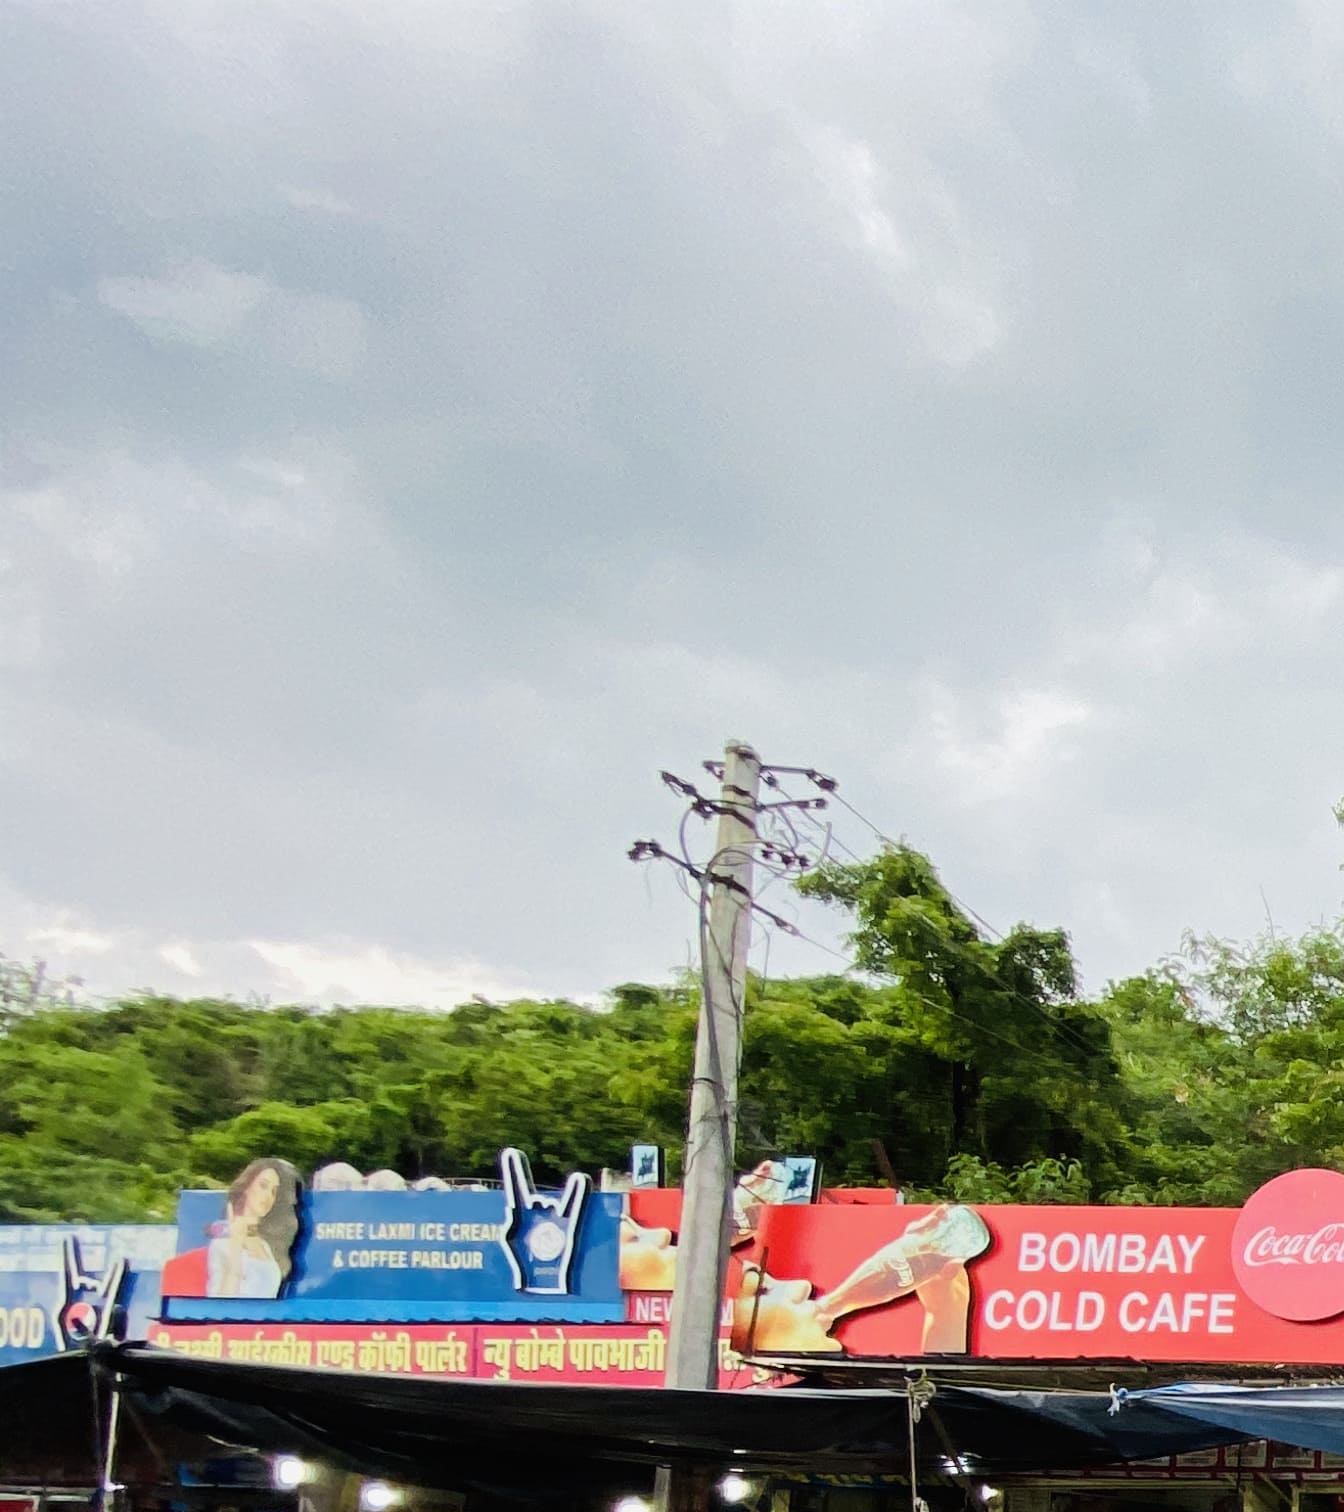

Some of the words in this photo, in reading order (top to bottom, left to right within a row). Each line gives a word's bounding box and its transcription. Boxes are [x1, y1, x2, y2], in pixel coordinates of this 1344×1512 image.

[316, 1223, 363, 1241] SHREE
[368, 1223, 416, 1241] LAXMI
[420, 1223, 445, 1241] ICE
[332, 1251, 344, 1269] &
[349, 1250, 408, 1269] COFFEE
[411, 1250, 484, 1270] PARLOUR
[1017, 1231, 1205, 1275] BOMBAY
[984, 1289, 1104, 1331] COLD
[1118, 1291, 1237, 1334] CAFE
